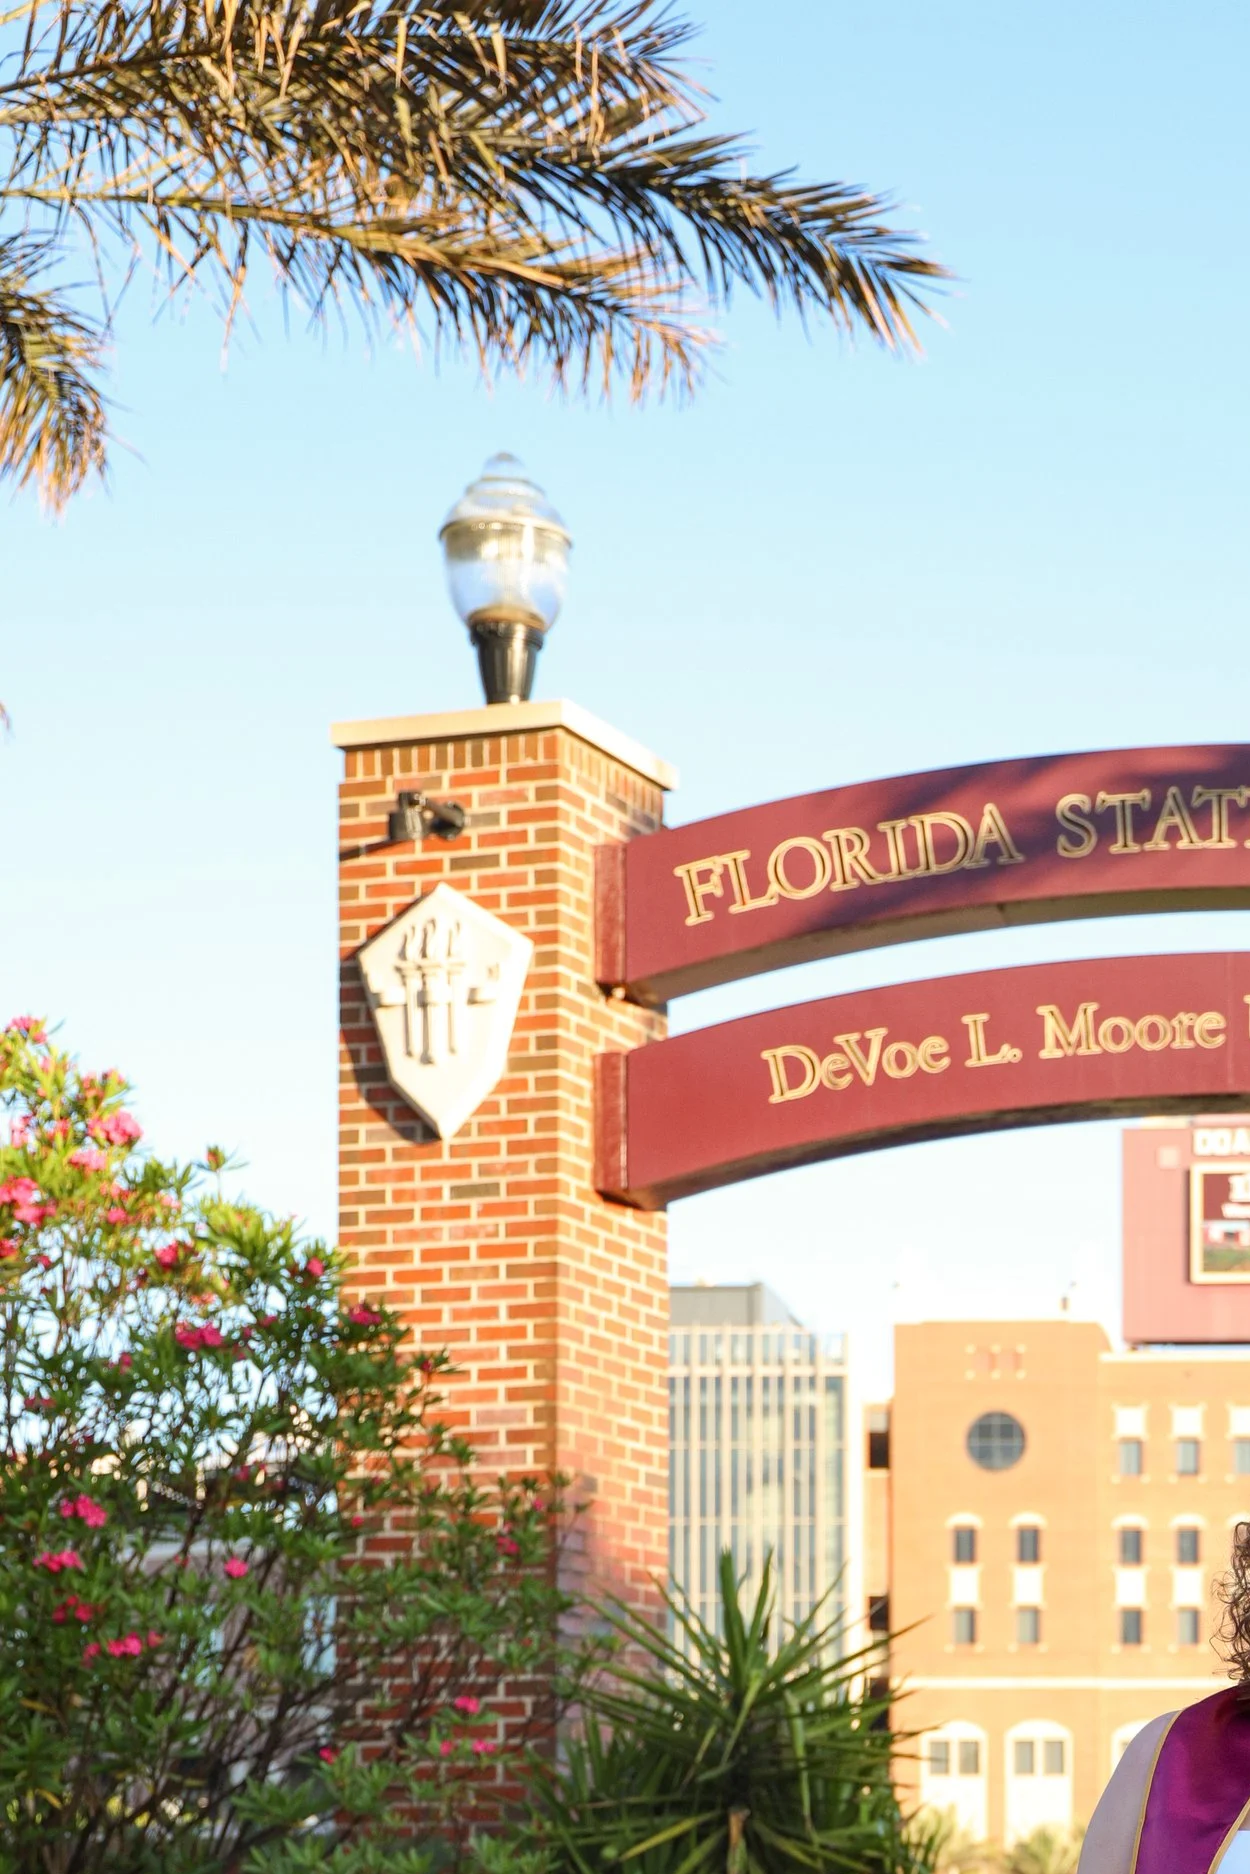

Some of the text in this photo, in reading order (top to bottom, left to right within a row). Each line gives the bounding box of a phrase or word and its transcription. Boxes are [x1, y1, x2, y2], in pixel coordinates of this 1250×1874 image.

[673, 803, 1027, 926] FLORIDA
[762, 1023, 950, 1106] DeVoe
[962, 1011, 1022, 1068] L.
[1036, 1001, 1227, 1060] Moore
